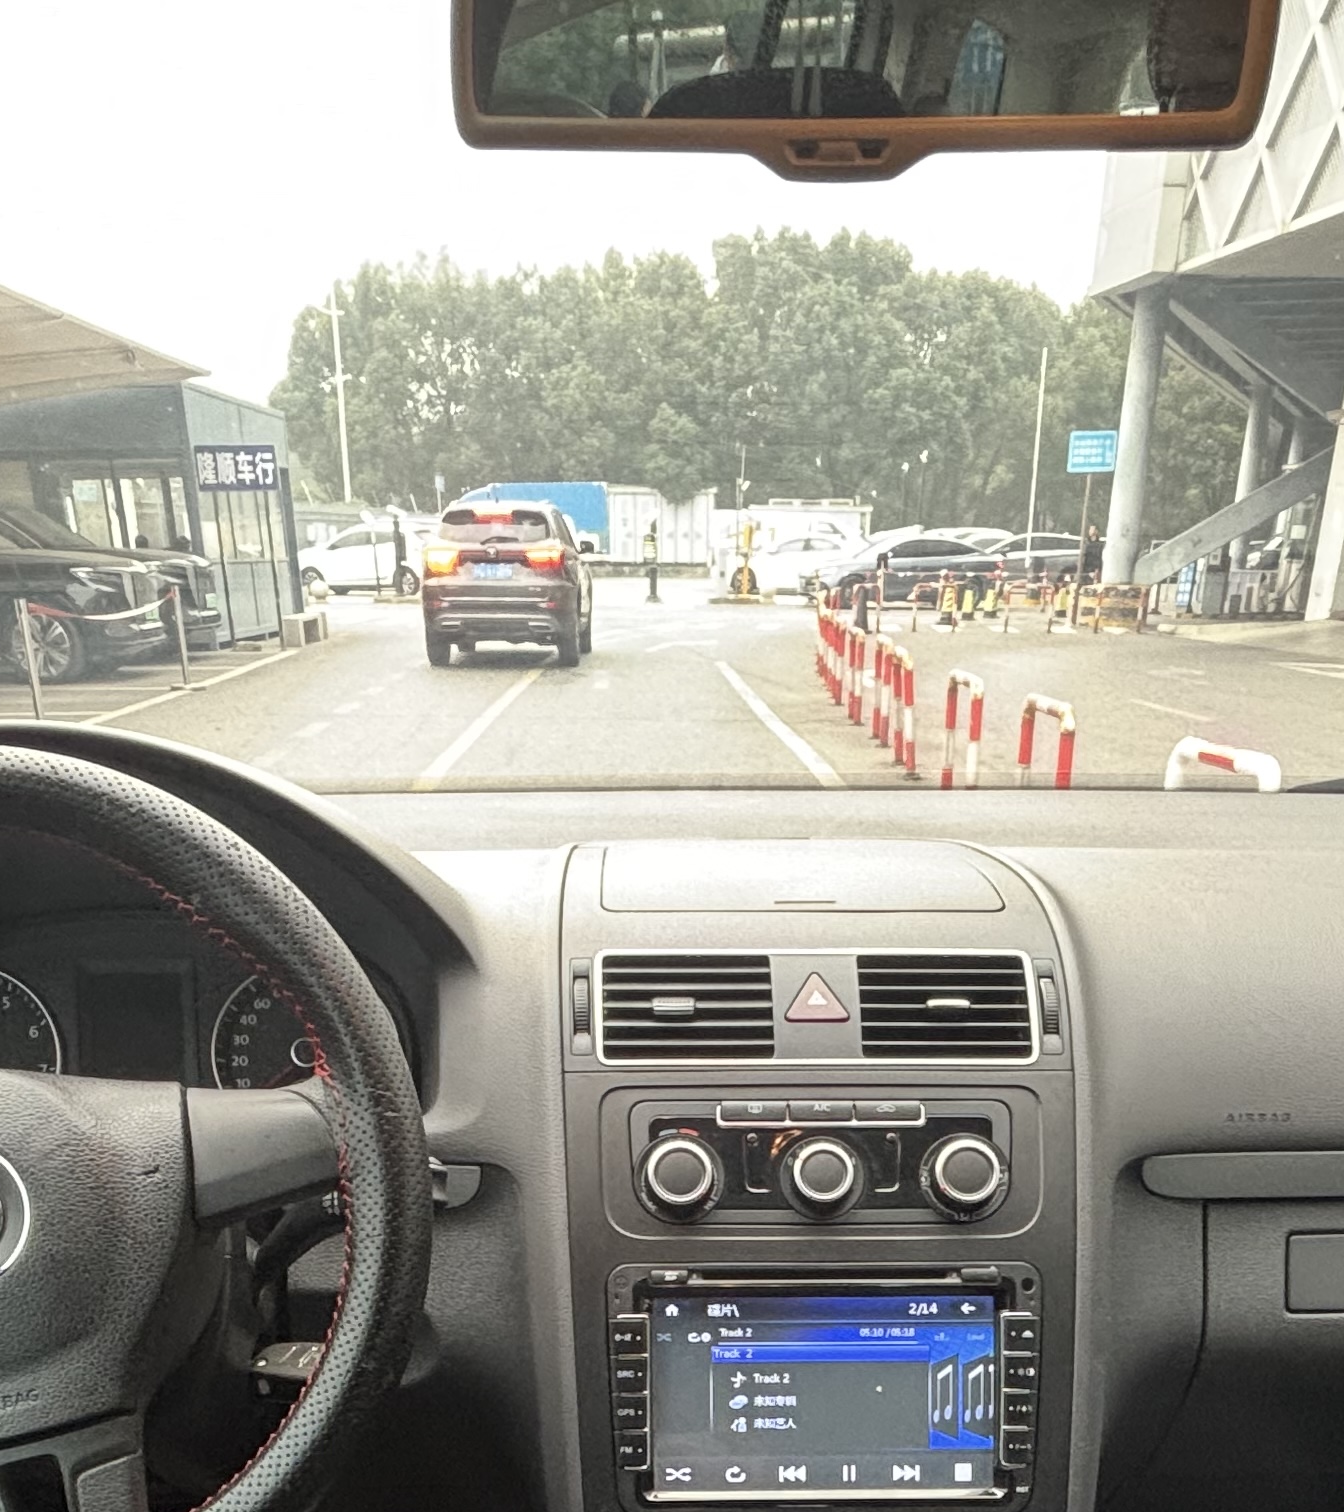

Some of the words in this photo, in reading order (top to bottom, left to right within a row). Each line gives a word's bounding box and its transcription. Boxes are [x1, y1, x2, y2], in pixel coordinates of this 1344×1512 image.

[196, 451, 275, 485] 隆顺车行
[2, 997, 10, 1009] 5
[239, 1014, 257, 1025] 40
[29, 1026, 39, 1038] 6
[233, 1034, 249, 1045] 30
[232, 1056, 249, 1066] 20
[813, 1103, 831, 1112] A/C
[908, 1302, 938, 1316] 2/14
[718, 1328, 743, 1338] Track
[745, 1328, 753, 1338] 2
[714, 1348, 741, 1359] Track
[745, 1348, 753, 1359] 2
[616, 1370, 635, 1378] SRC
[753, 1372, 780, 1384] Track
[782, 1372, 790, 1384] 2
[617, 1408, 635, 1416] GPS
[619, 1446, 633, 1454] FM
